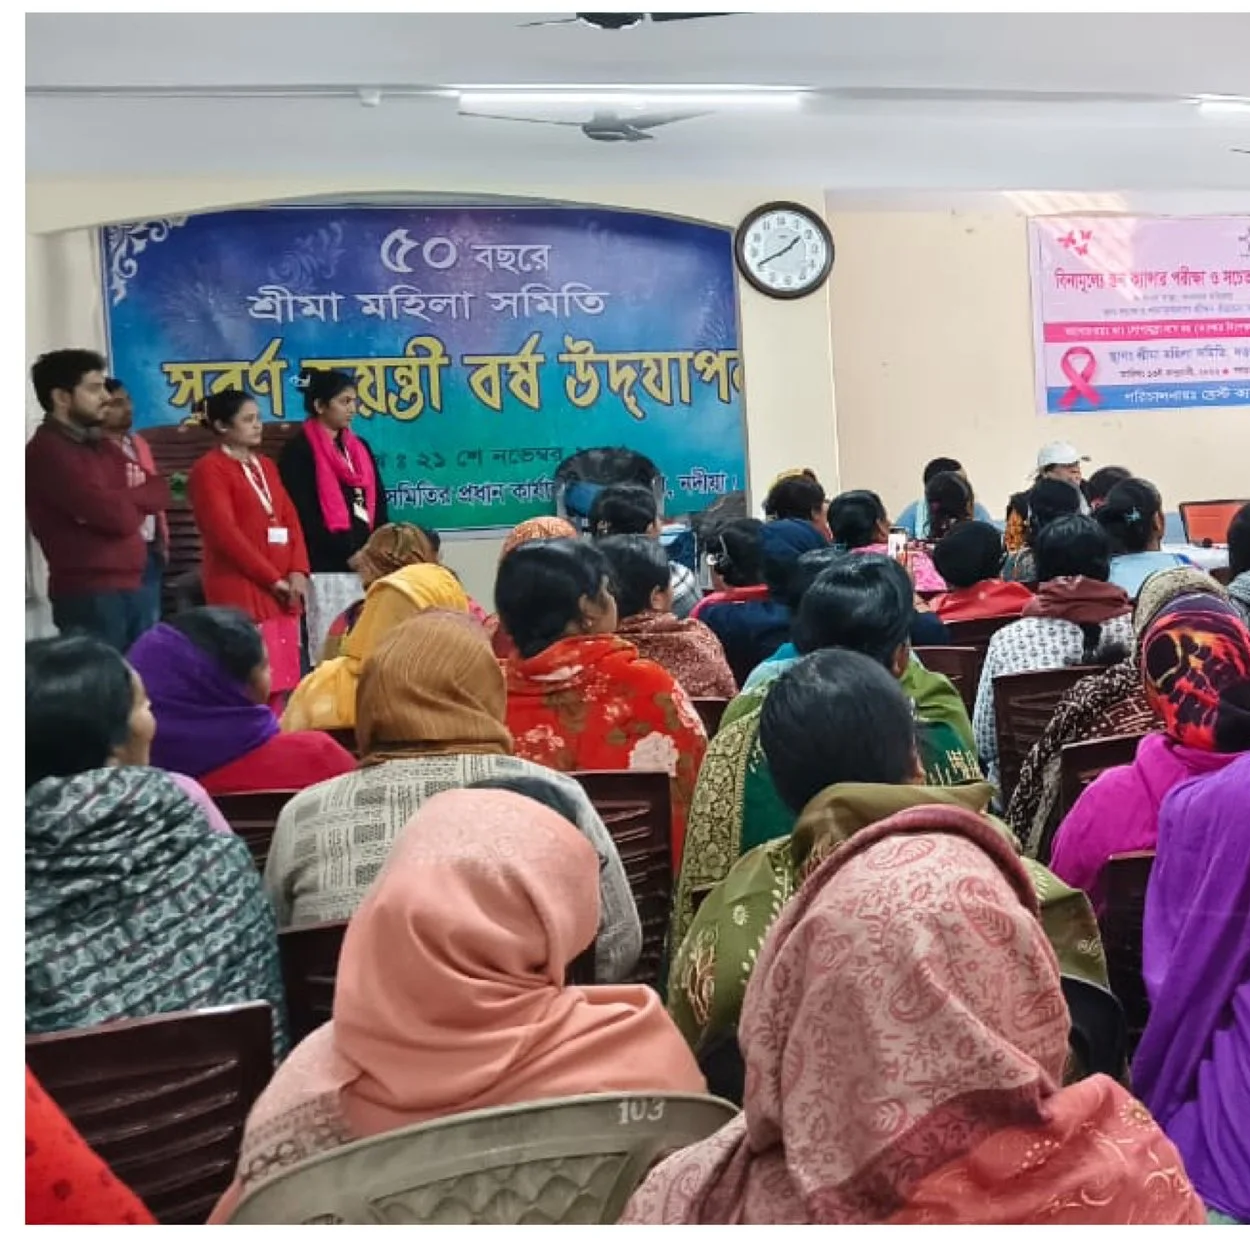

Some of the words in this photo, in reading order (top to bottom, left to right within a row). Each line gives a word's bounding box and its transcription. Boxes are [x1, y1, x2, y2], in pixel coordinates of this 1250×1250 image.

[380, 229, 458, 273] ৫০
[471, 243, 552, 274] বছরে
[248, 285, 345, 323] শ্রীমা
[355, 285, 475, 322] মহিলা
[485, 283, 611, 320] সমিতি
[300, 333, 450, 421] য়ন্তী
[461, 330, 545, 413] বর্ষ
[618, 1098, 665, 1125] 103
